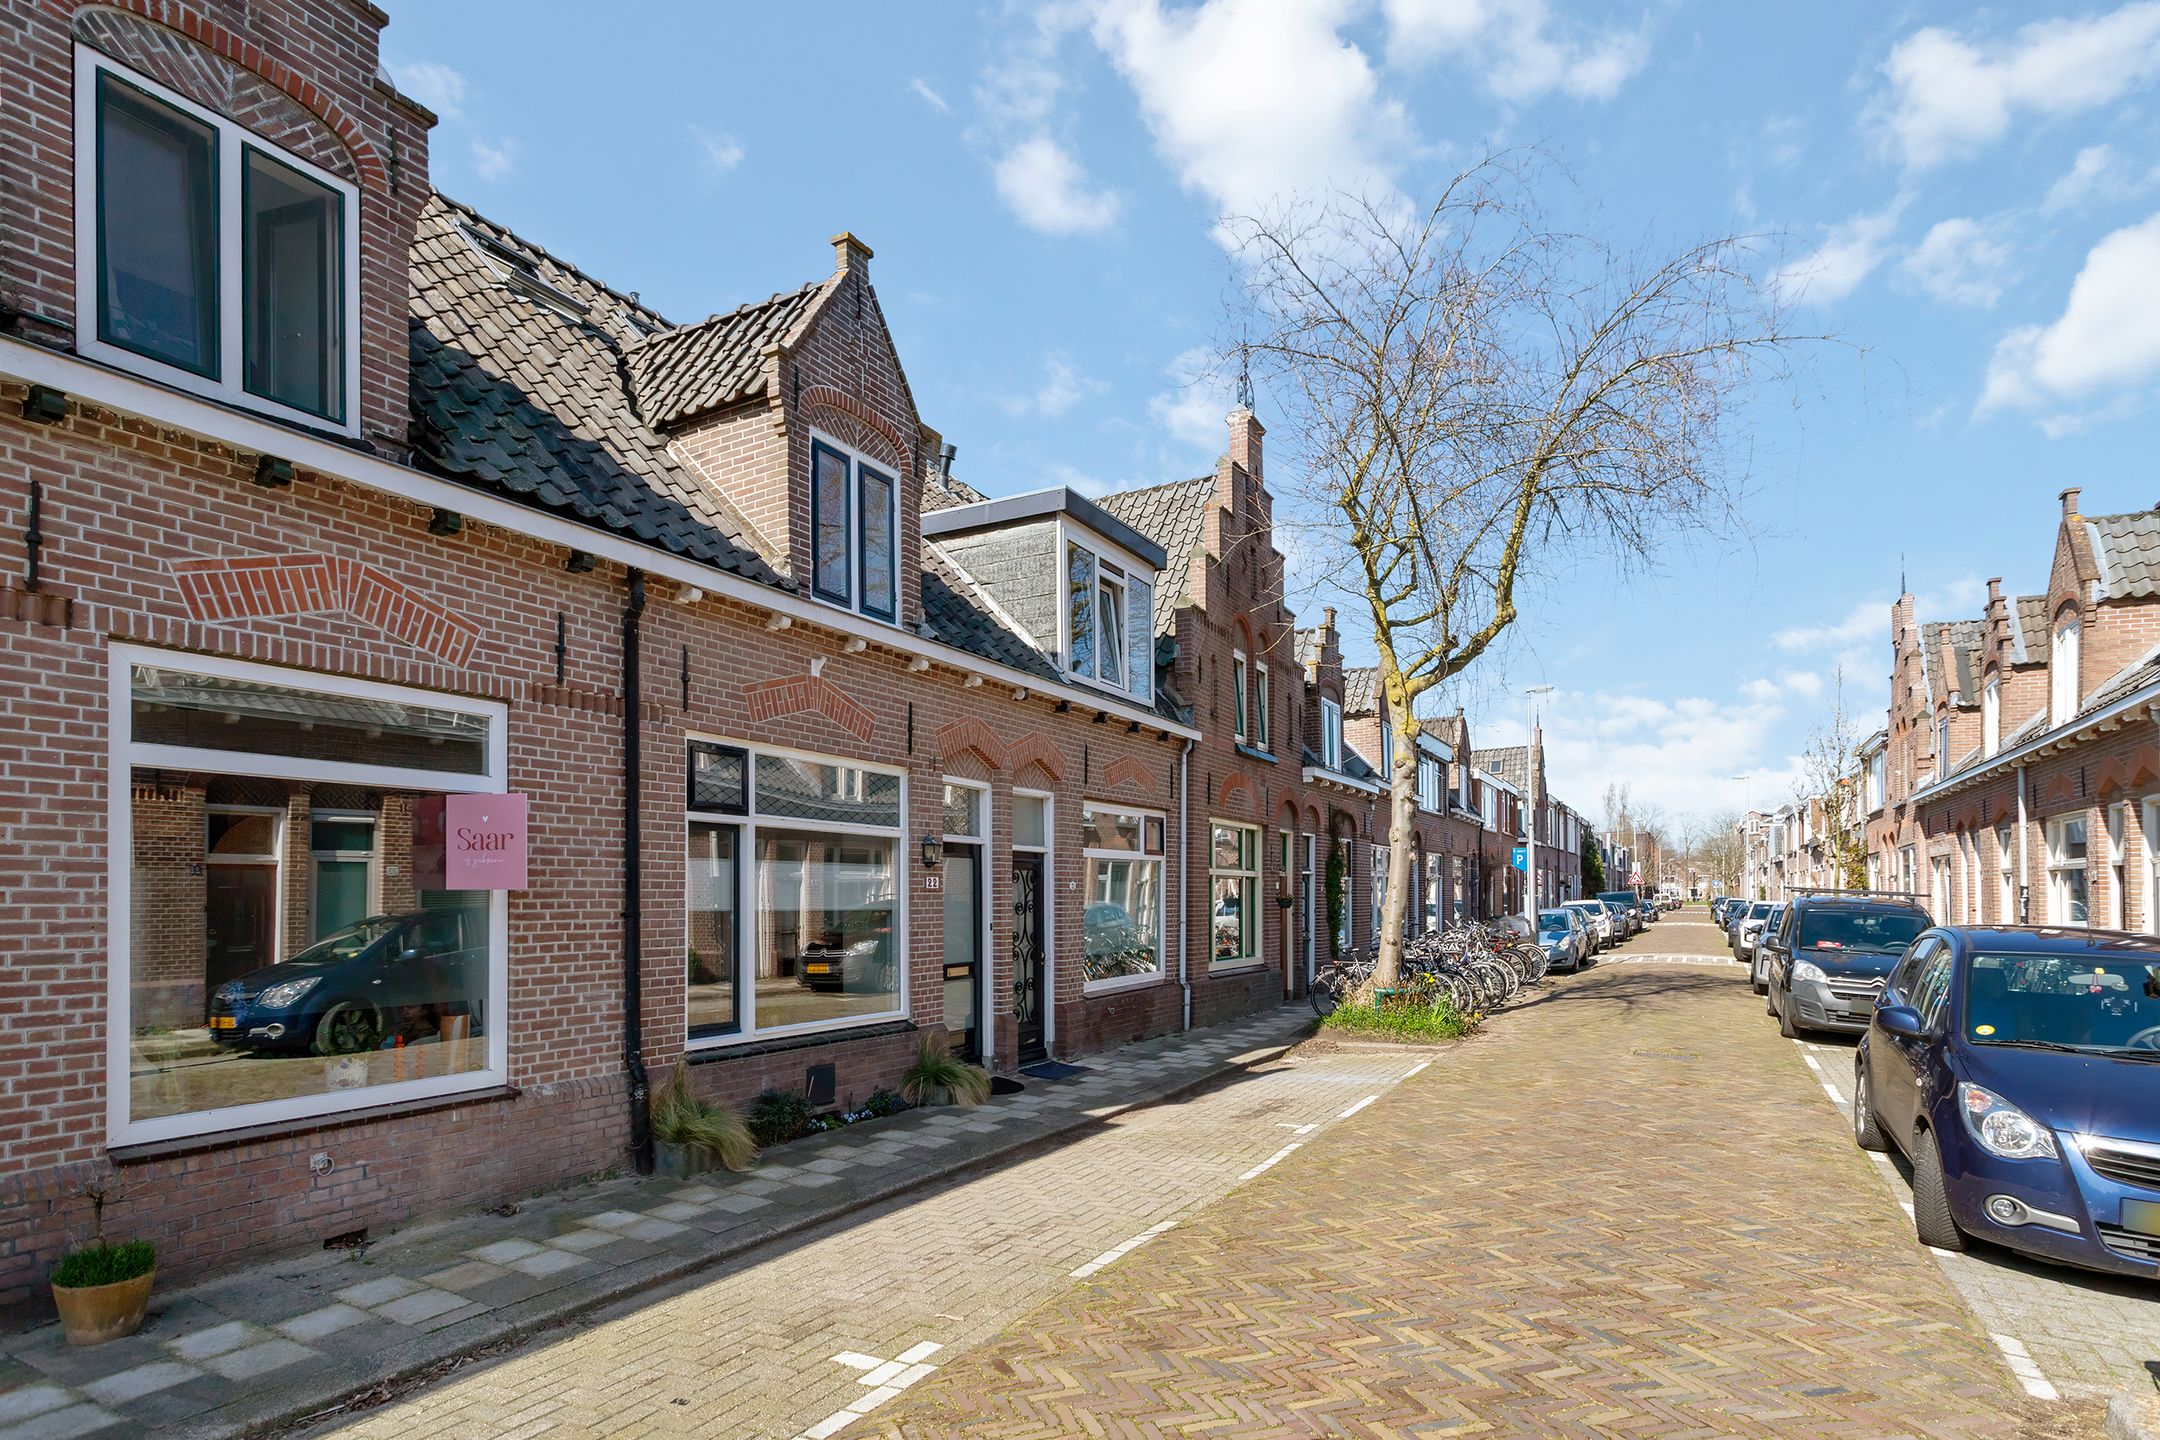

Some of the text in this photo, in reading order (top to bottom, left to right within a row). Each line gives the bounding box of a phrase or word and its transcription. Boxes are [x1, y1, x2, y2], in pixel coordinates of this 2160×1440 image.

[457, 827, 514, 851] Saar
[1516, 854, 1524, 865] P
[927, 877, 938, 888] 22
